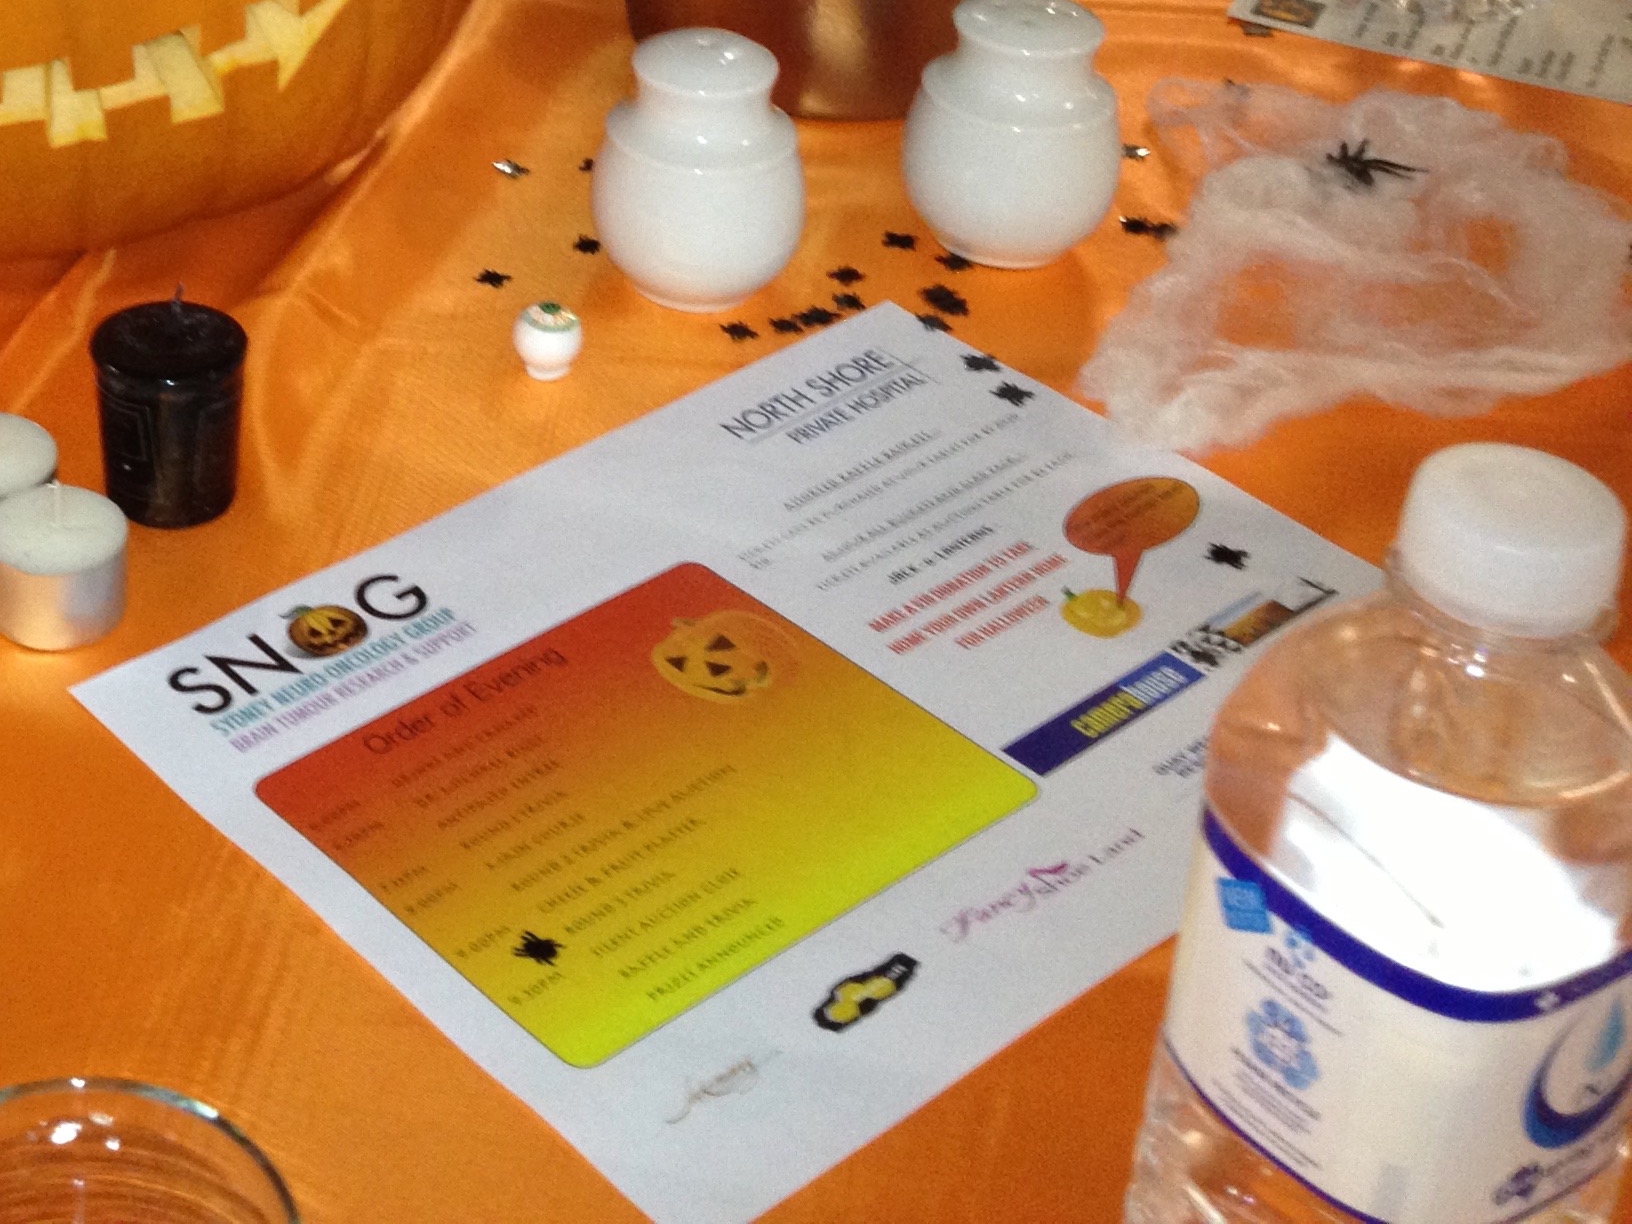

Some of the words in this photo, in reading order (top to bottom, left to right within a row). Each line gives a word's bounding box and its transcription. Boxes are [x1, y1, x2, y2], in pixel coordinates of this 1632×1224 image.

[719, 387, 816, 439] NORTH
[804, 349, 894, 397] SHORE
[785, 407, 853, 444] PRIVATE
[845, 372, 926, 414] HOSPITAL
[210, 698, 274, 733] SYDNEY
[402, 607, 455, 639] GROUP
[229, 722, 279, 752] BRAIN
[274, 692, 337, 727] TUMOUR
[333, 658, 404, 698] RESEARCH
[412, 620, 476, 657] SUPPORT
[361, 712, 435, 755] Order
[438, 690, 469, 718] of
[462, 647, 568, 702] Evening
